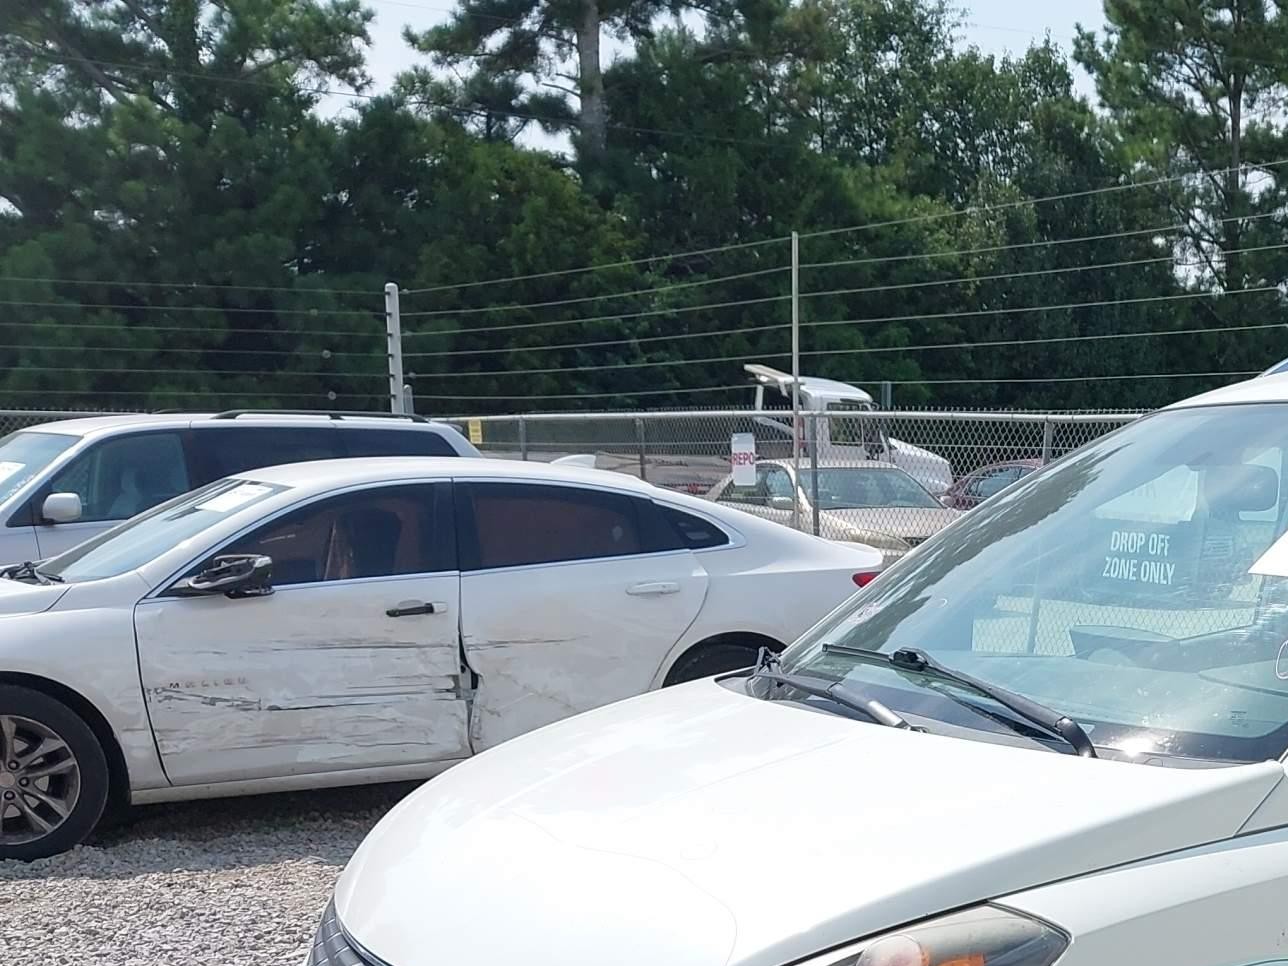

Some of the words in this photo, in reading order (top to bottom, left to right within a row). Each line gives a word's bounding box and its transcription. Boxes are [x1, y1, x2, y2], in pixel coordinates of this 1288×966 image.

[1110, 531, 1146, 553] DROP
[1148, 533, 1171, 557] OFF
[1102, 557, 1138, 581] ZONE
[1140, 561, 1176, 585] ONLY
